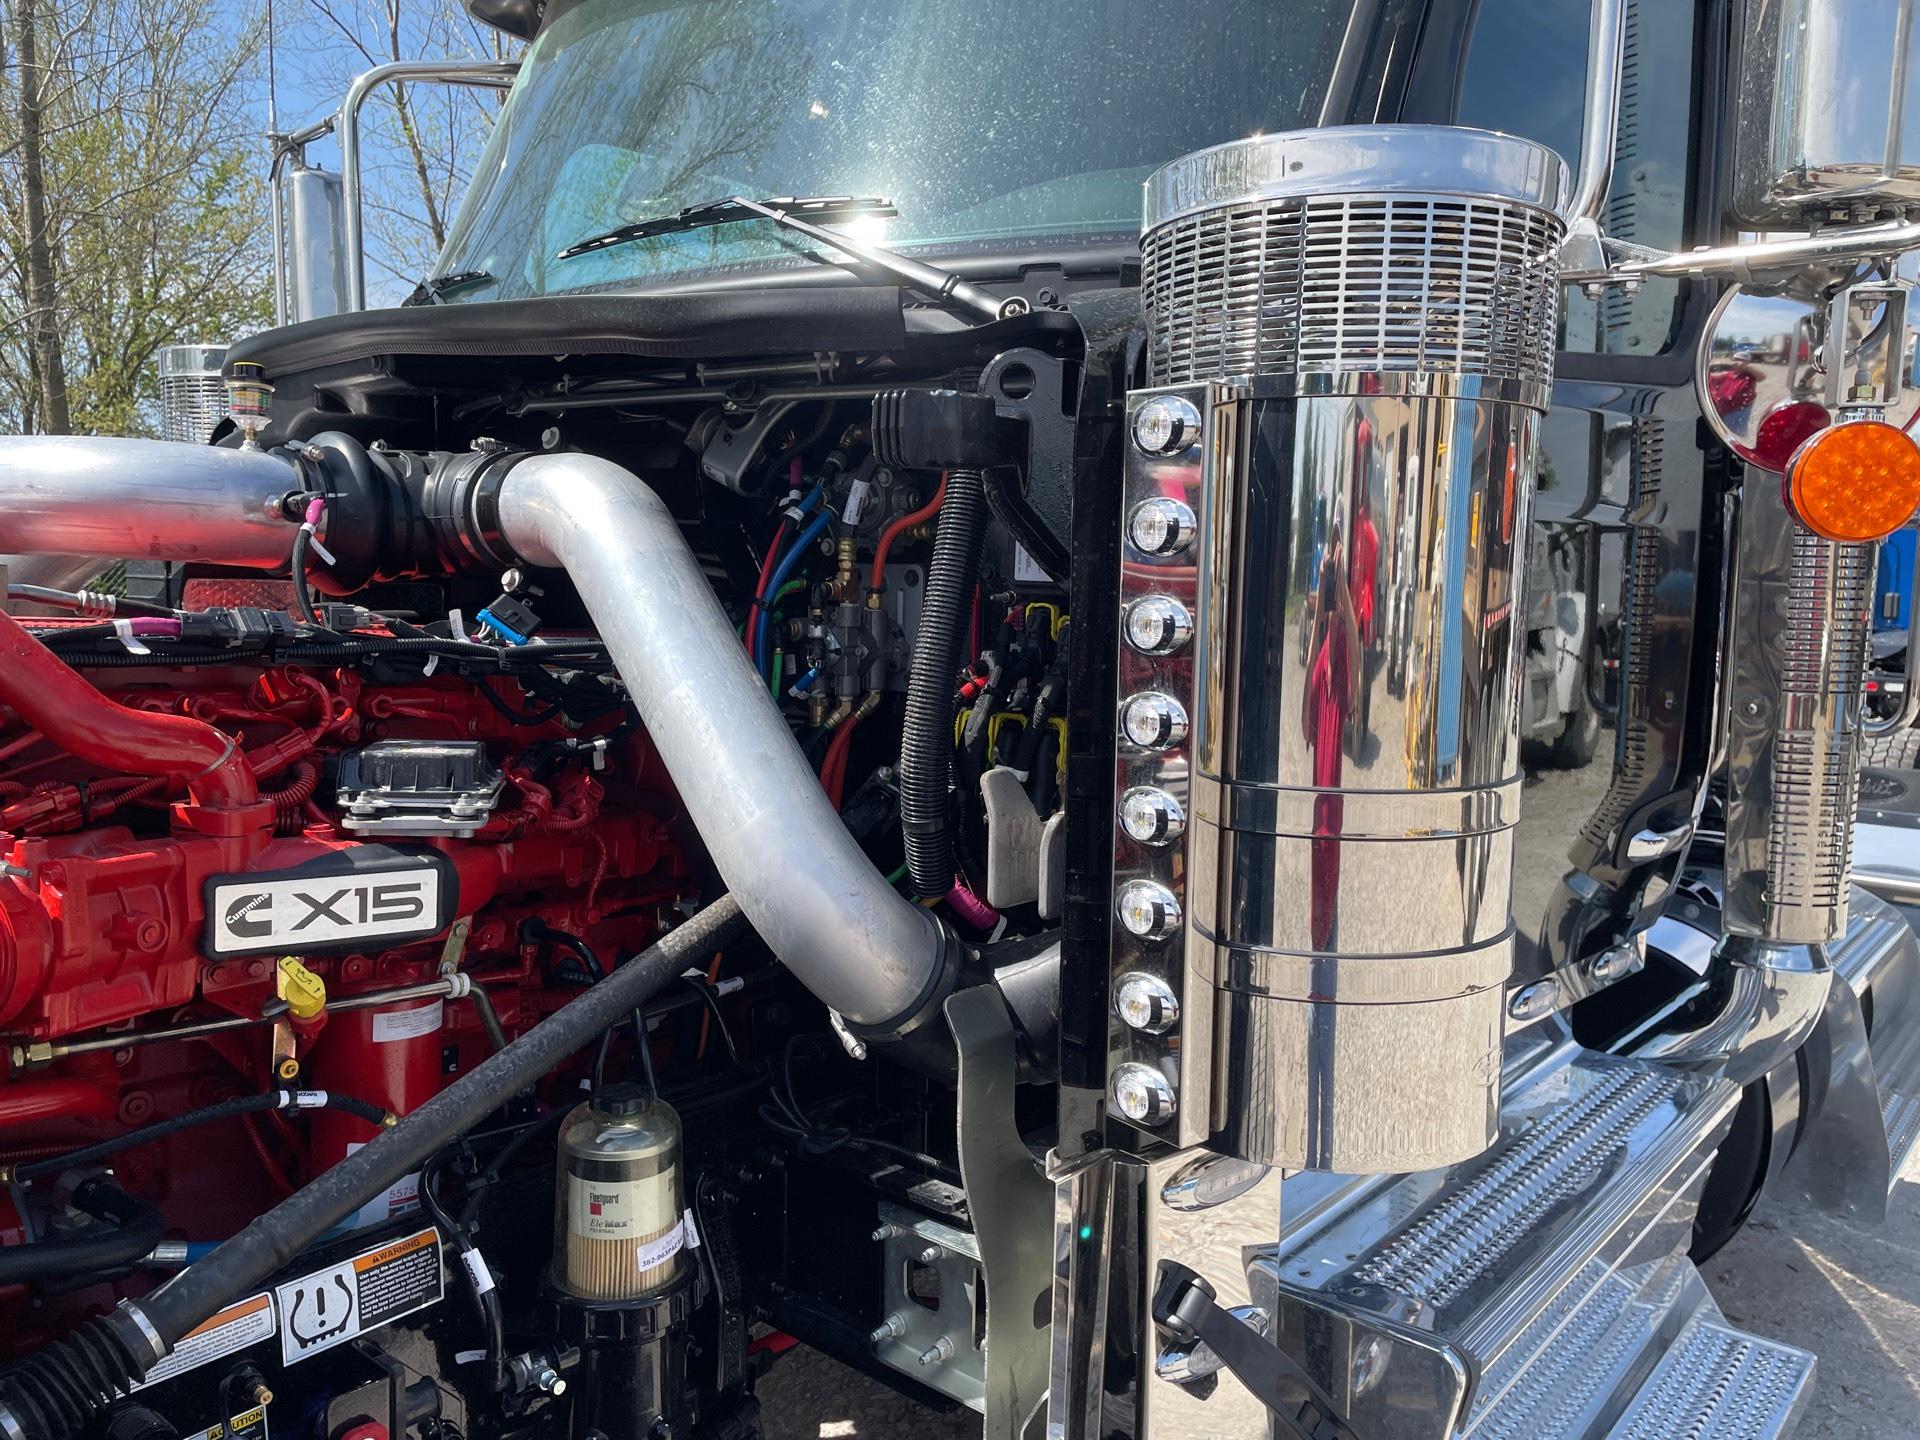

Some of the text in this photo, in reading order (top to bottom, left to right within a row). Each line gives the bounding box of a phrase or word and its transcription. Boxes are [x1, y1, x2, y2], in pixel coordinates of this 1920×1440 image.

[226, 893, 270, 924] Cummins
[290, 883, 424, 931] X15
[590, 1192, 619, 1206] Fleetguard
[380, 1238, 420, 1260] WARNING
